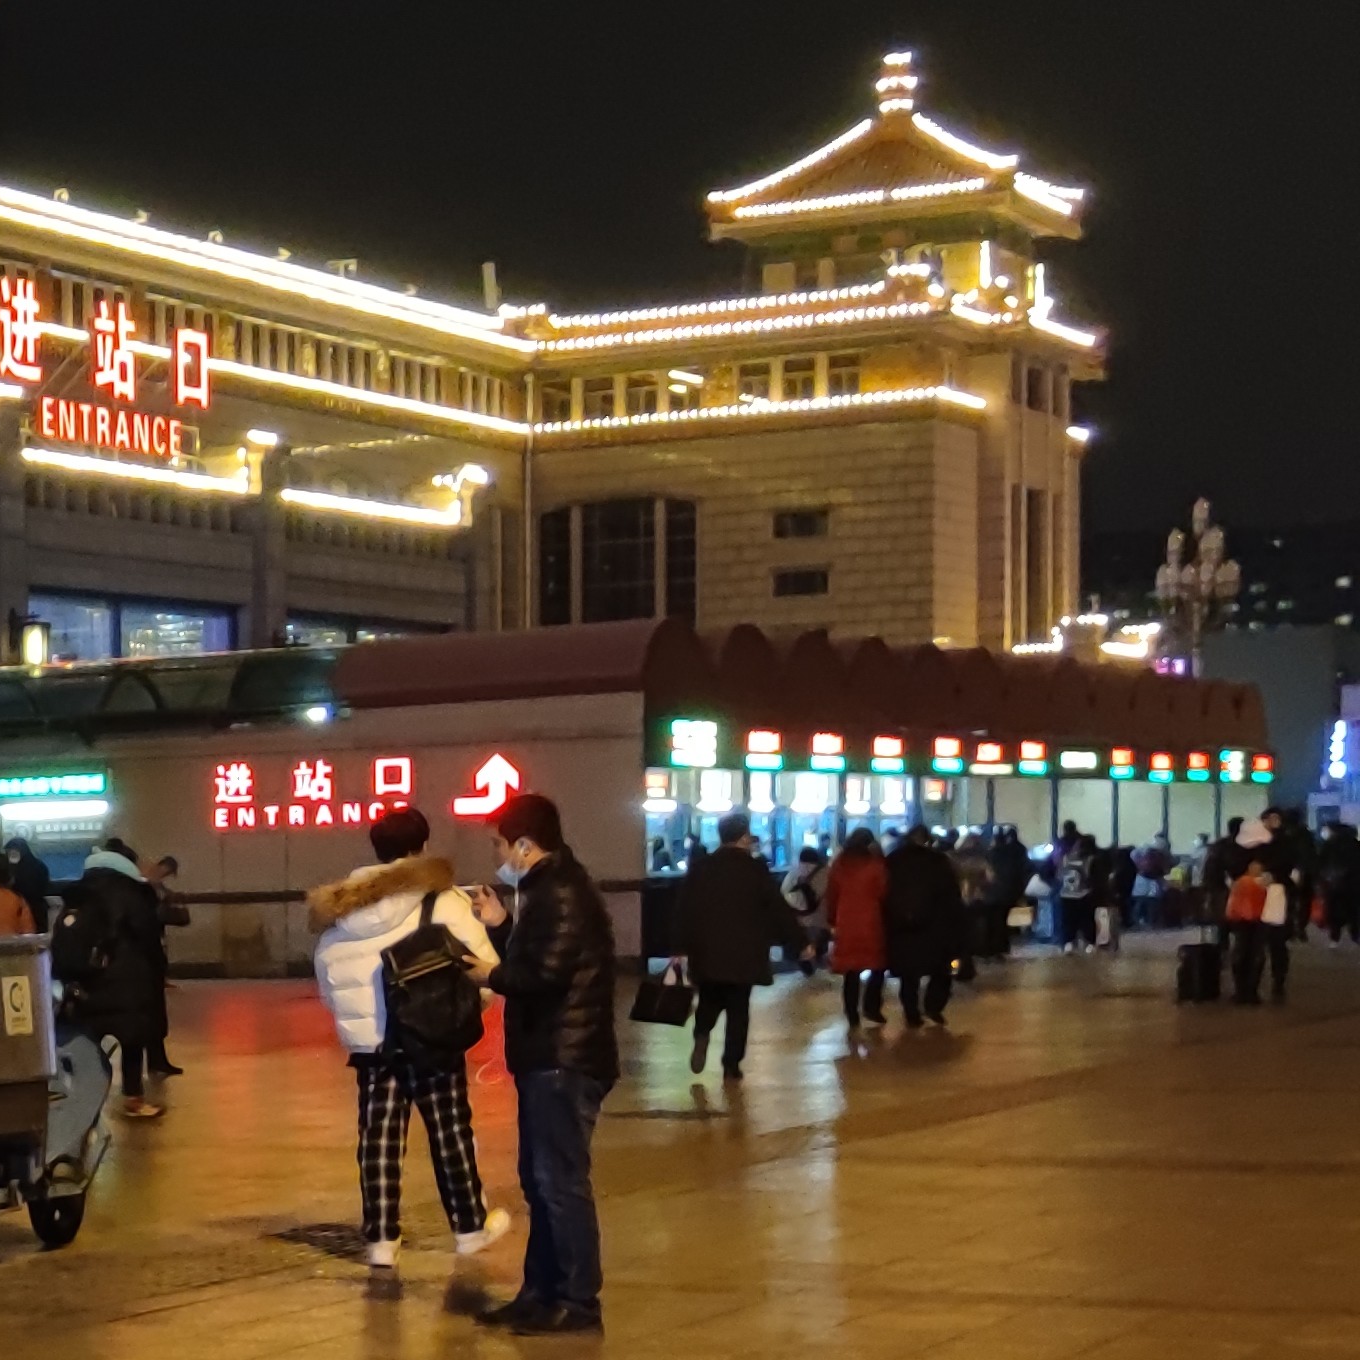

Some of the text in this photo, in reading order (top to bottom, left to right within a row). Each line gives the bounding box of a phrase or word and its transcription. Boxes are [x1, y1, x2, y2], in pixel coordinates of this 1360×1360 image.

[41, 397, 182, 456] ENTRANCE
[214, 757, 412, 803] 进站口
[214, 802, 408, 828] ENTRANC
